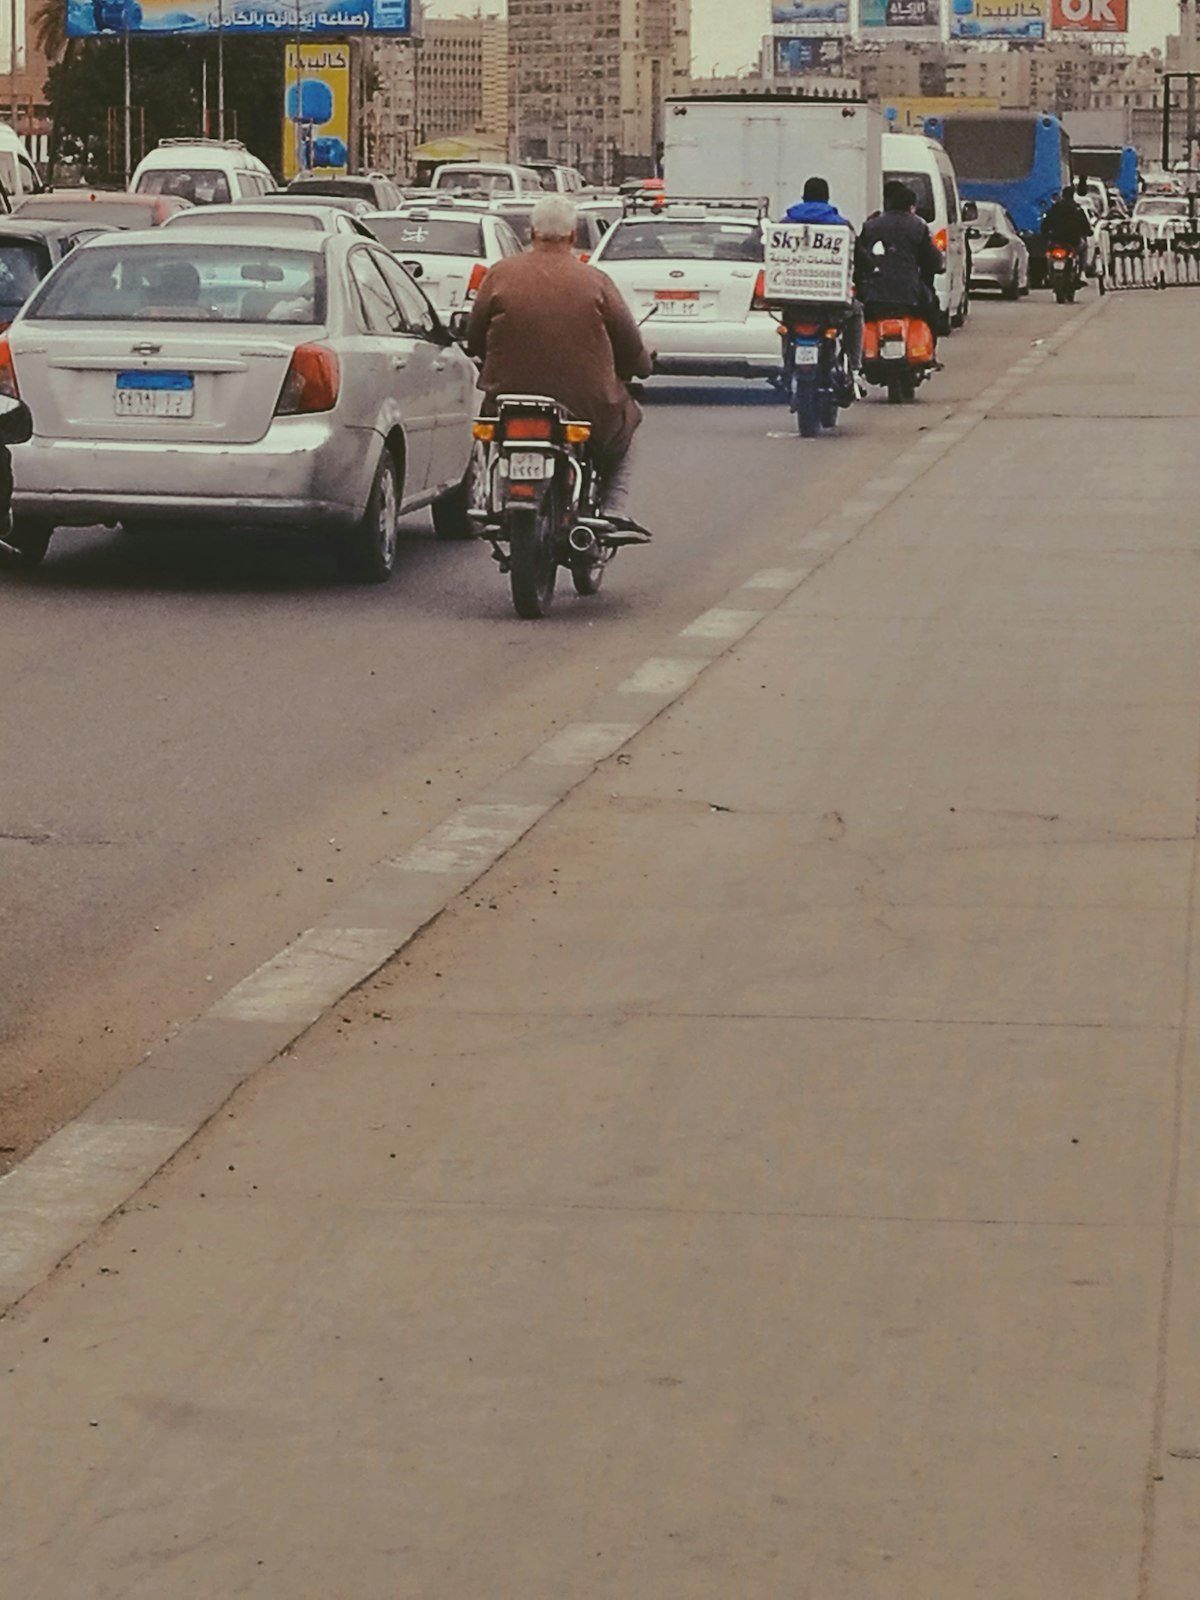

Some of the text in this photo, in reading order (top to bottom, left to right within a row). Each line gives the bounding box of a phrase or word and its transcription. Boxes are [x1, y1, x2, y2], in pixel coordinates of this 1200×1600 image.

[976, 2, 1041, 21] كالبيدا
[771, 231, 843, 255] Sky Bag
